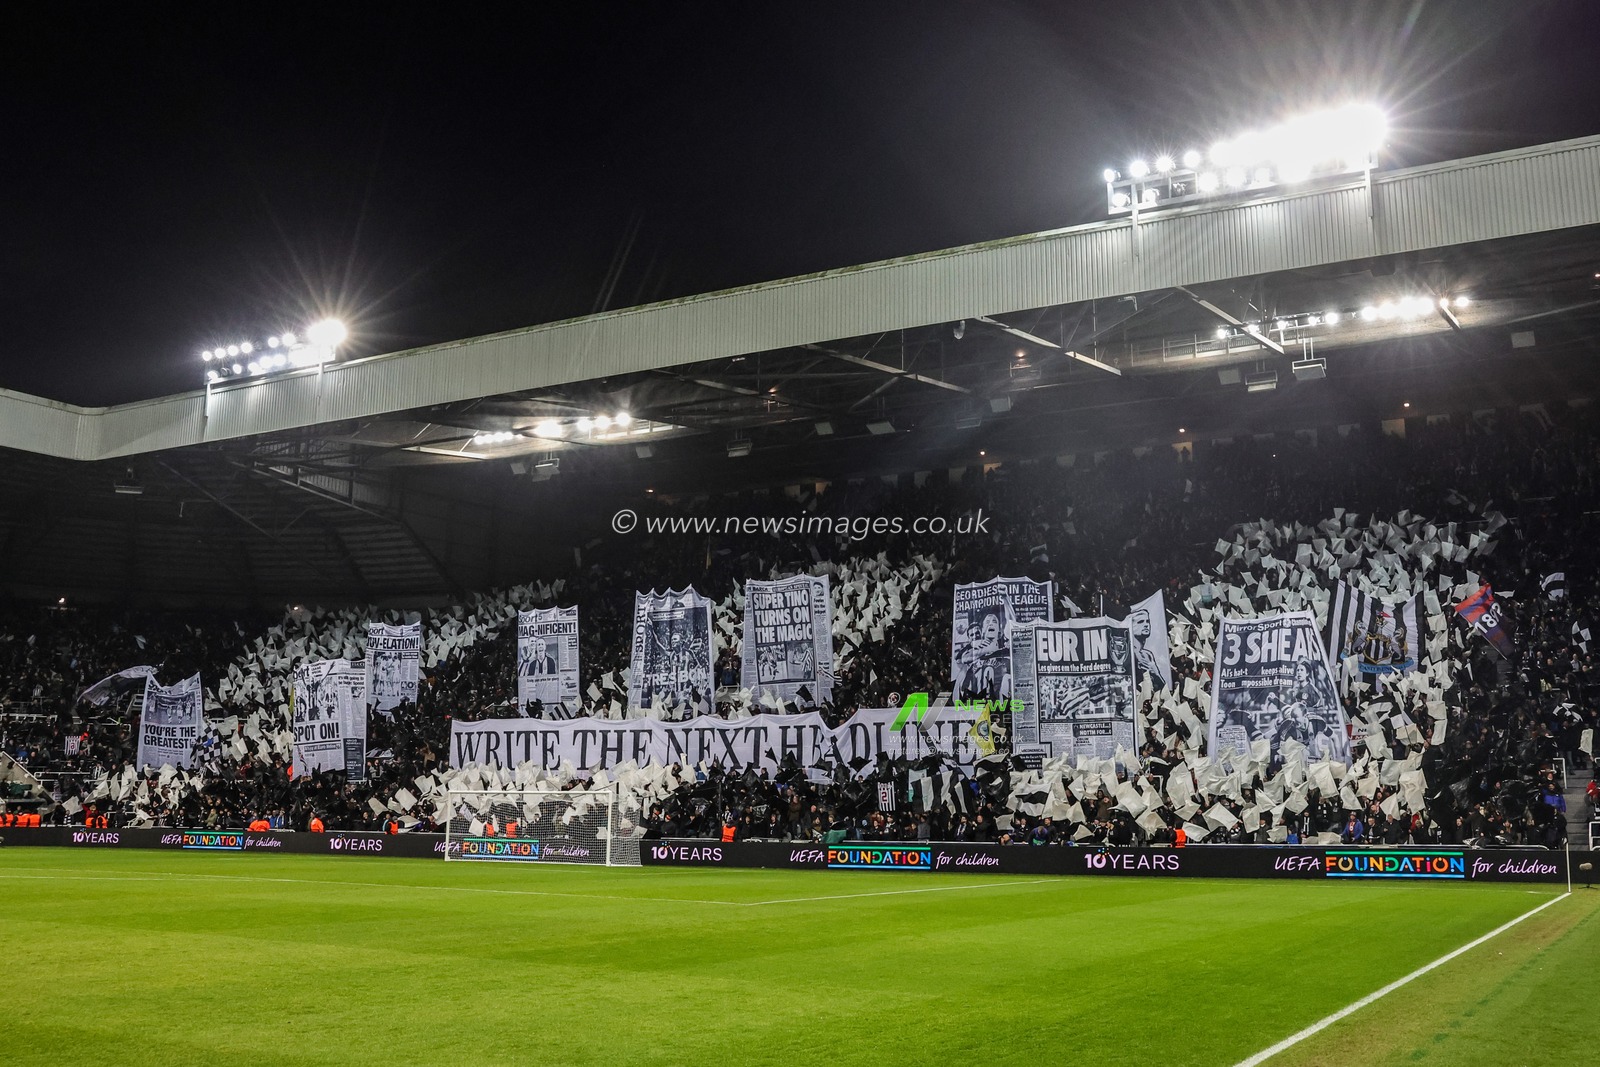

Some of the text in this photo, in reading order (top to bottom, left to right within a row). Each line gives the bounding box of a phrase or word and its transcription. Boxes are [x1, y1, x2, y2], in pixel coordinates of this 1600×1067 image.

[753, 589, 809, 610] SUPER TINO
[955, 584, 1041, 601] GEORDIES IN THE
[955, 594, 1048, 612] CHAMPIONS LEAGUE
[755, 606, 810, 626] TURNS ON
[756, 622, 812, 644] THE MAGIC
[1036, 628, 1108, 662] EUR IN
[1222, 628, 1322, 666] 3 SHEARS
[1038, 664, 1046, 672] Les
[1047, 664, 1060, 673] gives
[1070, 664, 1080, 672] the
[1080, 663, 1093, 671] Ferd
[1094, 663, 1111, 672] degree
[1221, 668, 1233, 678] Al's
[1262, 667, 1278, 676] keeps
[1278, 664, 1294, 675] alive
[1220, 680, 1236, 688] Toon
[1274, 678, 1292, 686] dream
[145, 724, 196, 738] YOU'RE THE
[294, 722, 340, 742] SPOT ON!
[454, 730, 560, 771] WRITE
[573, 729, 652, 770] THE
[665, 724, 768, 769] NEXT
[882, 792, 888, 802] 2
[161, 834, 282, 849] UEFA FOUNDATION for children
[434, 841, 460, 852] UEFA
[462, 842, 539, 856] FOUNDATION
[542, 842, 554, 858] for
[790, 850, 999, 868] UEFA FOUNDATION for children
[1274, 856, 1558, 878] UEFA FOUNDATION for children
